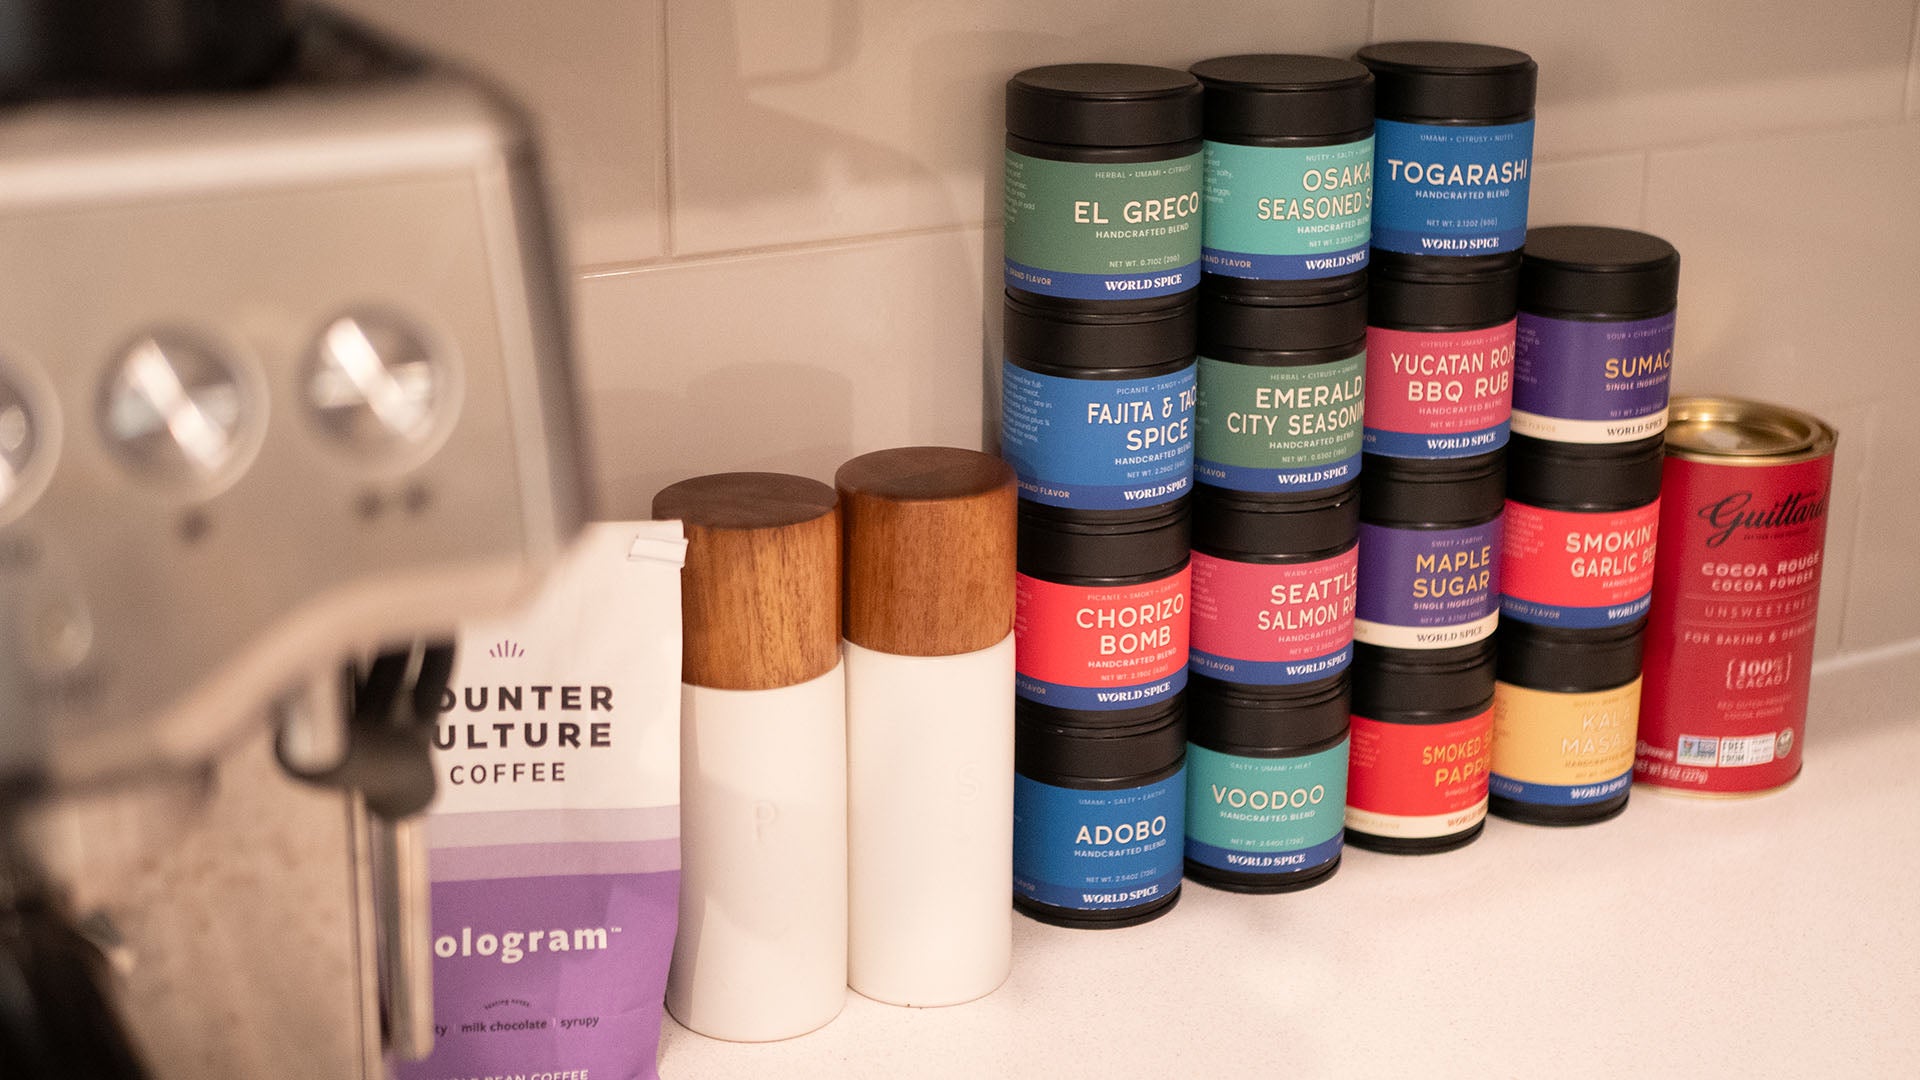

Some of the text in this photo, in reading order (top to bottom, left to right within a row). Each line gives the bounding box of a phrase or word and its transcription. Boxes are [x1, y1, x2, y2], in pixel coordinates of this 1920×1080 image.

[1456, 135, 1487, 143] CITRUSY
[1306, 154, 1330, 163] NUTTY
[1095, 171, 1127, 179] HERBAL
[1135, 170, 1161, 178] UMAMI
[1302, 161, 1371, 192] OSAKA
[1387, 158, 1528, 186] TOGARASHI
[1415, 188, 1510, 200] HANDCRAFTED BLEND
[1074, 191, 1199, 224] EL GRECO
[1257, 187, 1373, 221] SEASONED S
[1095, 222, 1190, 239] HANDCRAFTED BLEND
[1297, 220, 1357, 234] HANDCRAFTED
[1426, 219, 1440, 227] NET
[1421, 237, 1500, 250] WORLD SPICE
[1109, 260, 1123, 268] NET
[1221, 257, 1252, 268] FLAVOR
[1305, 250, 1366, 271] WORLD SPICE
[1025, 273, 1052, 286] FLAVOR
[1104, 273, 1183, 291] WORLD SPICE
[1391, 352, 1484, 376] YUCATAN
[1604, 349, 1671, 379] SUMAC
[1270, 374, 1300, 382] HERBAL
[1408, 371, 1509, 403] BBQ RUB
[1605, 383, 1635, 392] SINGLE
[1116, 386, 1149, 396] PICANTE
[1256, 375, 1363, 410] EMERALD
[1087, 400, 1154, 425] FAJITA
[1161, 396, 1174, 418] &
[1227, 399, 1365, 436] CITY SEASONIN
[1419, 403, 1483, 416] HANDCRAFTED
[1126, 417, 1189, 451] SPICE
[1606, 419, 1664, 437] WORLD SPICE
[1269, 430, 1355, 450] HANDCRAFTED BLEND
[1426, 431, 1497, 450] WORLD SPICE
[1115, 449, 1177, 466] HANDCRAFTED
[1282, 455, 1295, 463] NET
[1127, 471, 1140, 479] NET
[1278, 464, 1349, 484] WORLD SPICE
[1039, 486, 1070, 499] FLAVOR
[1123, 477, 1188, 501] WORLD SPICE
[1698, 487, 1828, 548] Guittard
[1416, 545, 1491, 574] MAPLE
[1571, 552, 1638, 578] GARLIC
[1702, 551, 1820, 577] COCOA ROUGE
[1270, 566, 1357, 605] SEATTLE
[1413, 570, 1490, 598] SUGAR
[1712, 578, 1763, 592] COCOA
[1087, 593, 1121, 601] PICANTE
[1413, 602, 1444, 610] SINGLE
[1076, 593, 1184, 629] CHORIZO
[1257, 602, 1338, 631] SALMON
[1608, 606, 1640, 620] WORLD
[1100, 625, 1171, 655] BOMB
[1278, 627, 1338, 643] HANDCRAFTED
[1416, 626, 1483, 643] WORLD SPICE
[1684, 631, 1711, 644] FOR
[1716, 632, 1763, 645] BAKING
[1088, 648, 1177, 668] HANDCRAFTED BLEND
[1206, 659, 1235, 672] FLAVOR
[1286, 651, 1348, 676] WORLD SPICE
[1735, 674, 1783, 690] CACAO
[440, 686, 614, 713] OUNTER
[1097, 681, 1171, 703] WORLD SPICE
[432, 722, 612, 750] ULTURE
[1423, 736, 1482, 766] SMOKED
[450, 762, 566, 785] COFFEE
[1113, 797, 1136, 806] SALTY
[1211, 784, 1325, 810] VOODOO
[1570, 785, 1609, 800] WORLD
[751, 800, 778, 843] P
[1220, 811, 1316, 823] HANDCRAFTED BLEND
[1075, 815, 1167, 845] ADOBO
[1074, 839, 1167, 858] HANDCRAFTED BLEND
[1227, 852, 1306, 867] WORLD SPICE
[1082, 884, 1159, 904] WORLD SPICE
[434, 927, 622, 964] ologram™
[461, 1016, 600, 1034] milk chocolate syrupy
